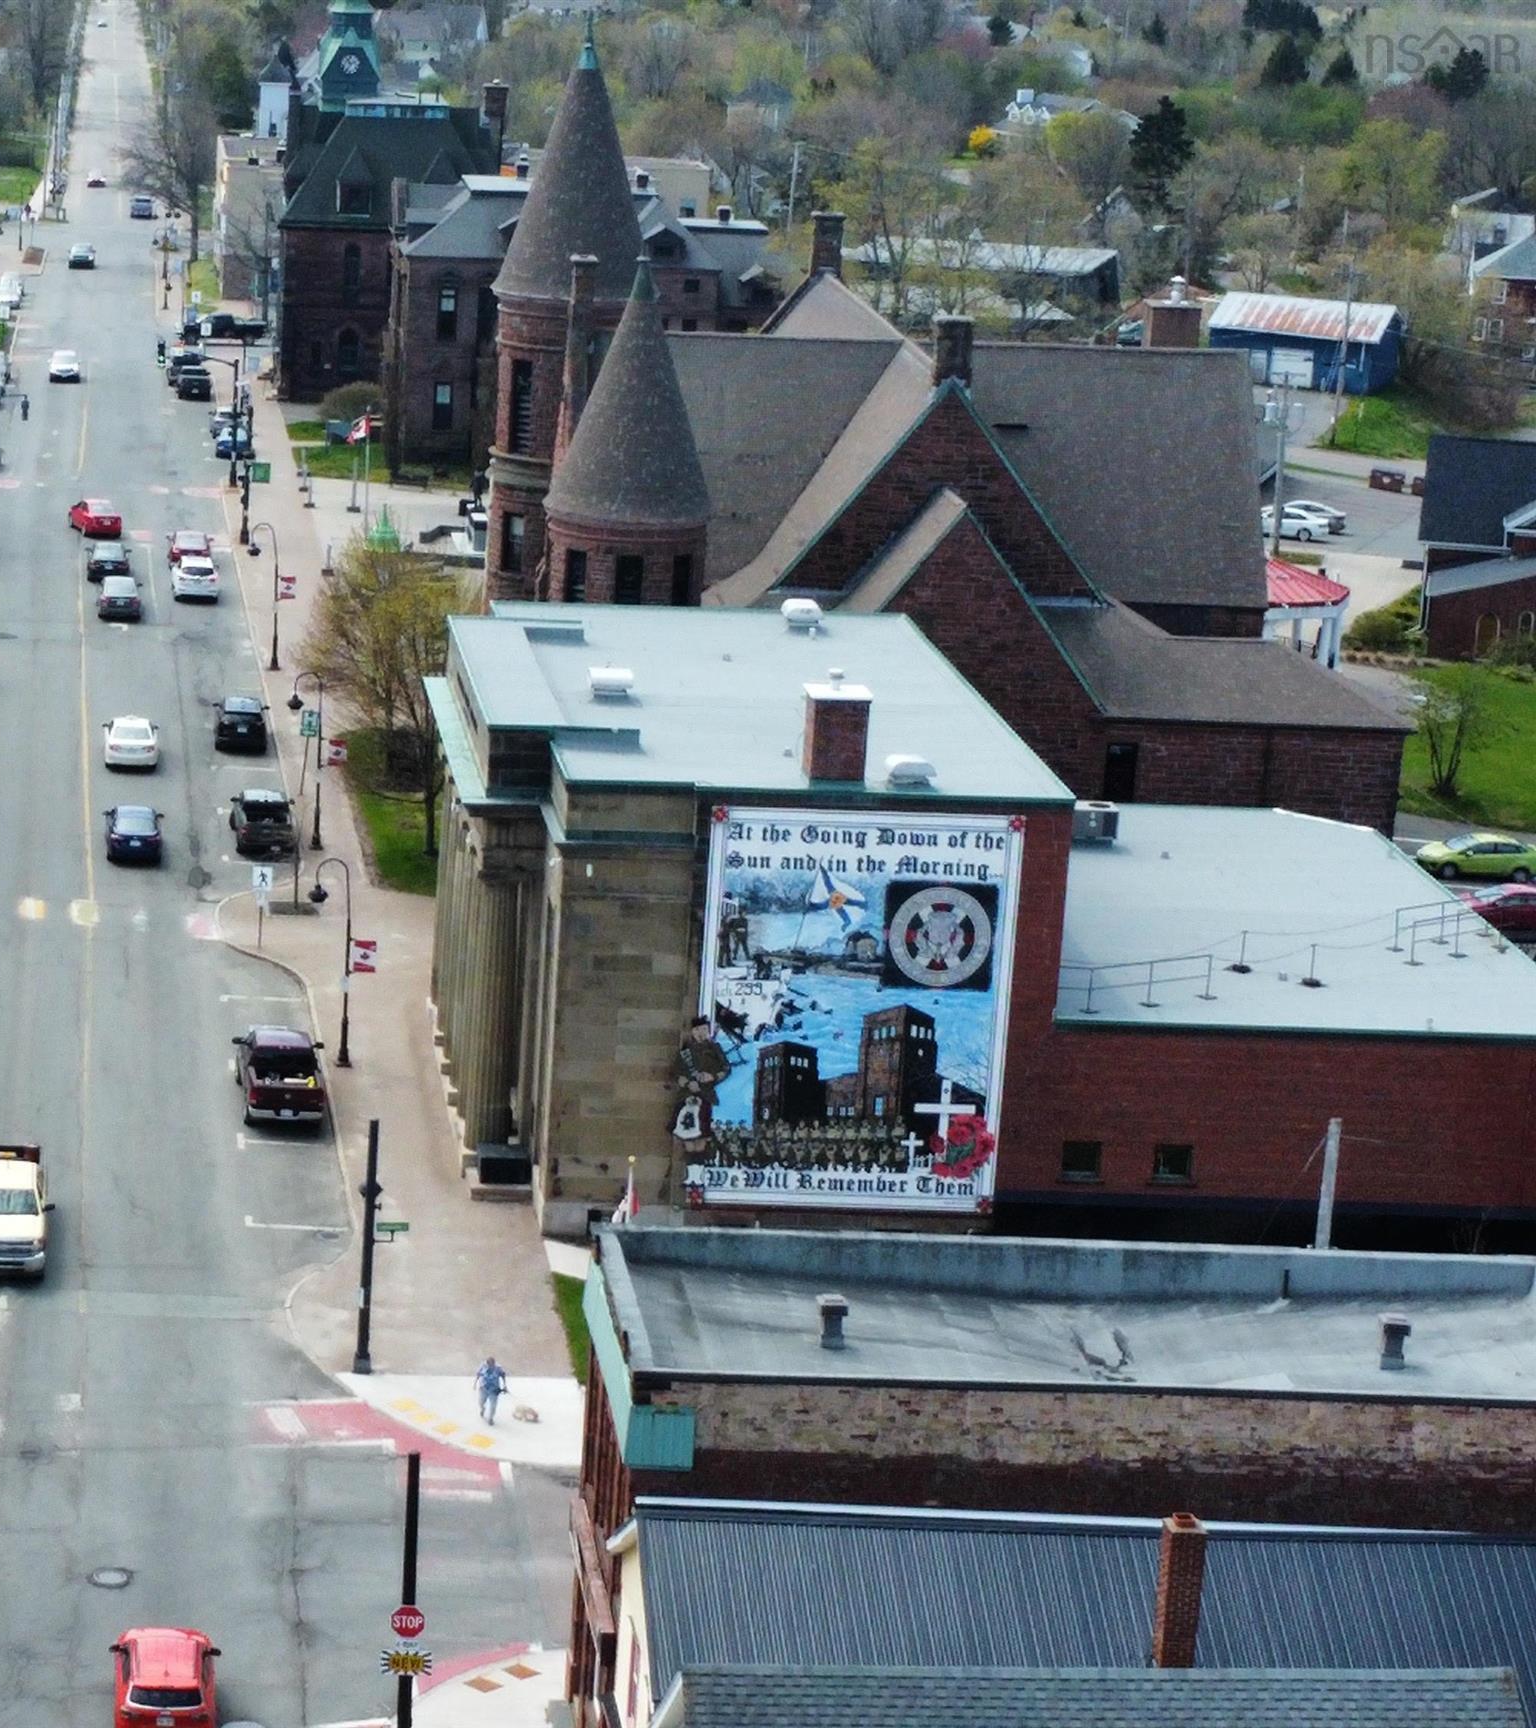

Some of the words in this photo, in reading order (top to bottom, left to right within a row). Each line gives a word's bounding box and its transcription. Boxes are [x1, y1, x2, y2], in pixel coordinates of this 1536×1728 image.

[728, 822, 753, 840] At
[762, 824, 791, 844] the
[801, 825, 867, 848] Going
[876, 827, 938, 847] Down
[948, 831, 969, 848] of
[975, 832, 1004, 851] the
[727, 850, 771, 869] Sun
[781, 853, 816, 871] and
[828, 855, 847, 872] in
[857, 855, 886, 873] the
[706, 1169, 739, 1188] We
[744, 1170, 788, 1189] Will
[798, 1172, 908, 1193] Remember
[916, 1176, 974, 1196] Them
[393, 1615, 423, 1628] STOP
